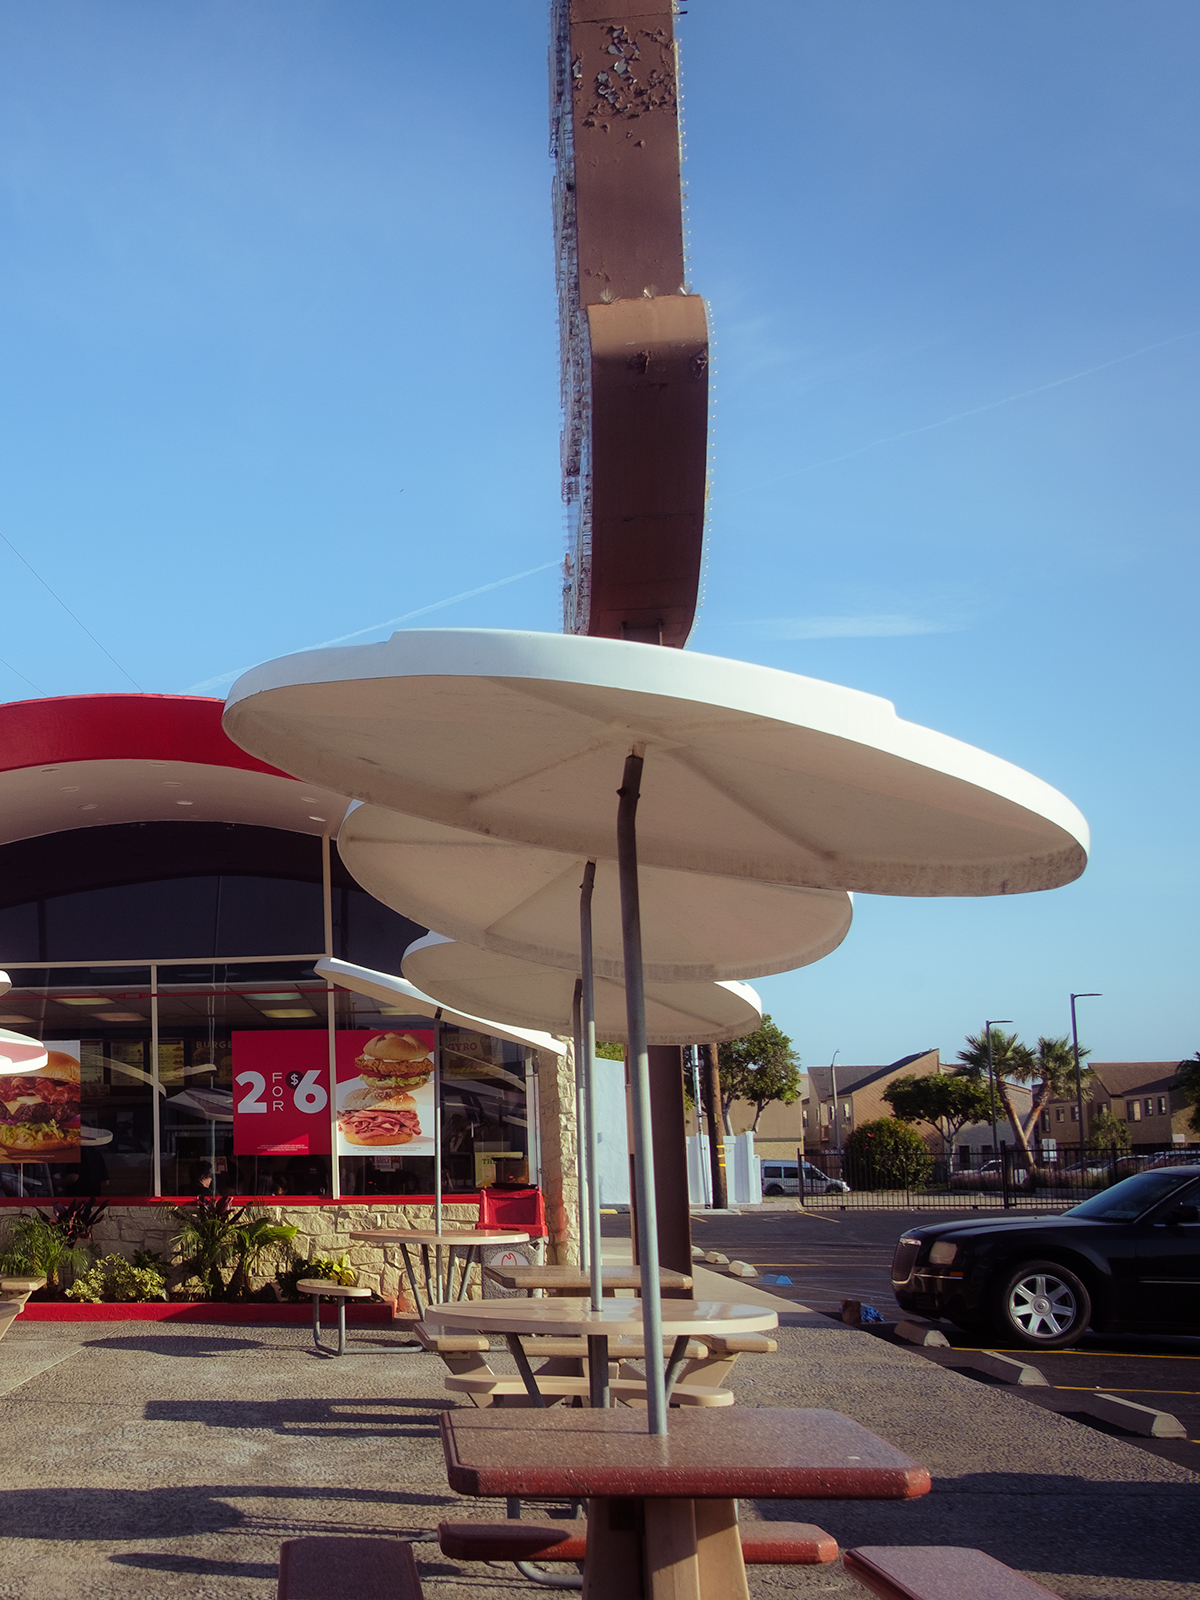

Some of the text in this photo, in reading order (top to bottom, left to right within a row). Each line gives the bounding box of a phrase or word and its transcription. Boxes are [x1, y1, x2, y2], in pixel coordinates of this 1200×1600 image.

[196, 1040, 232, 1049] BURGE
[448, 1042, 478, 1051] GYRO
[235, 1070, 267, 1113] 2
[272, 1072, 284, 1111] FOR
